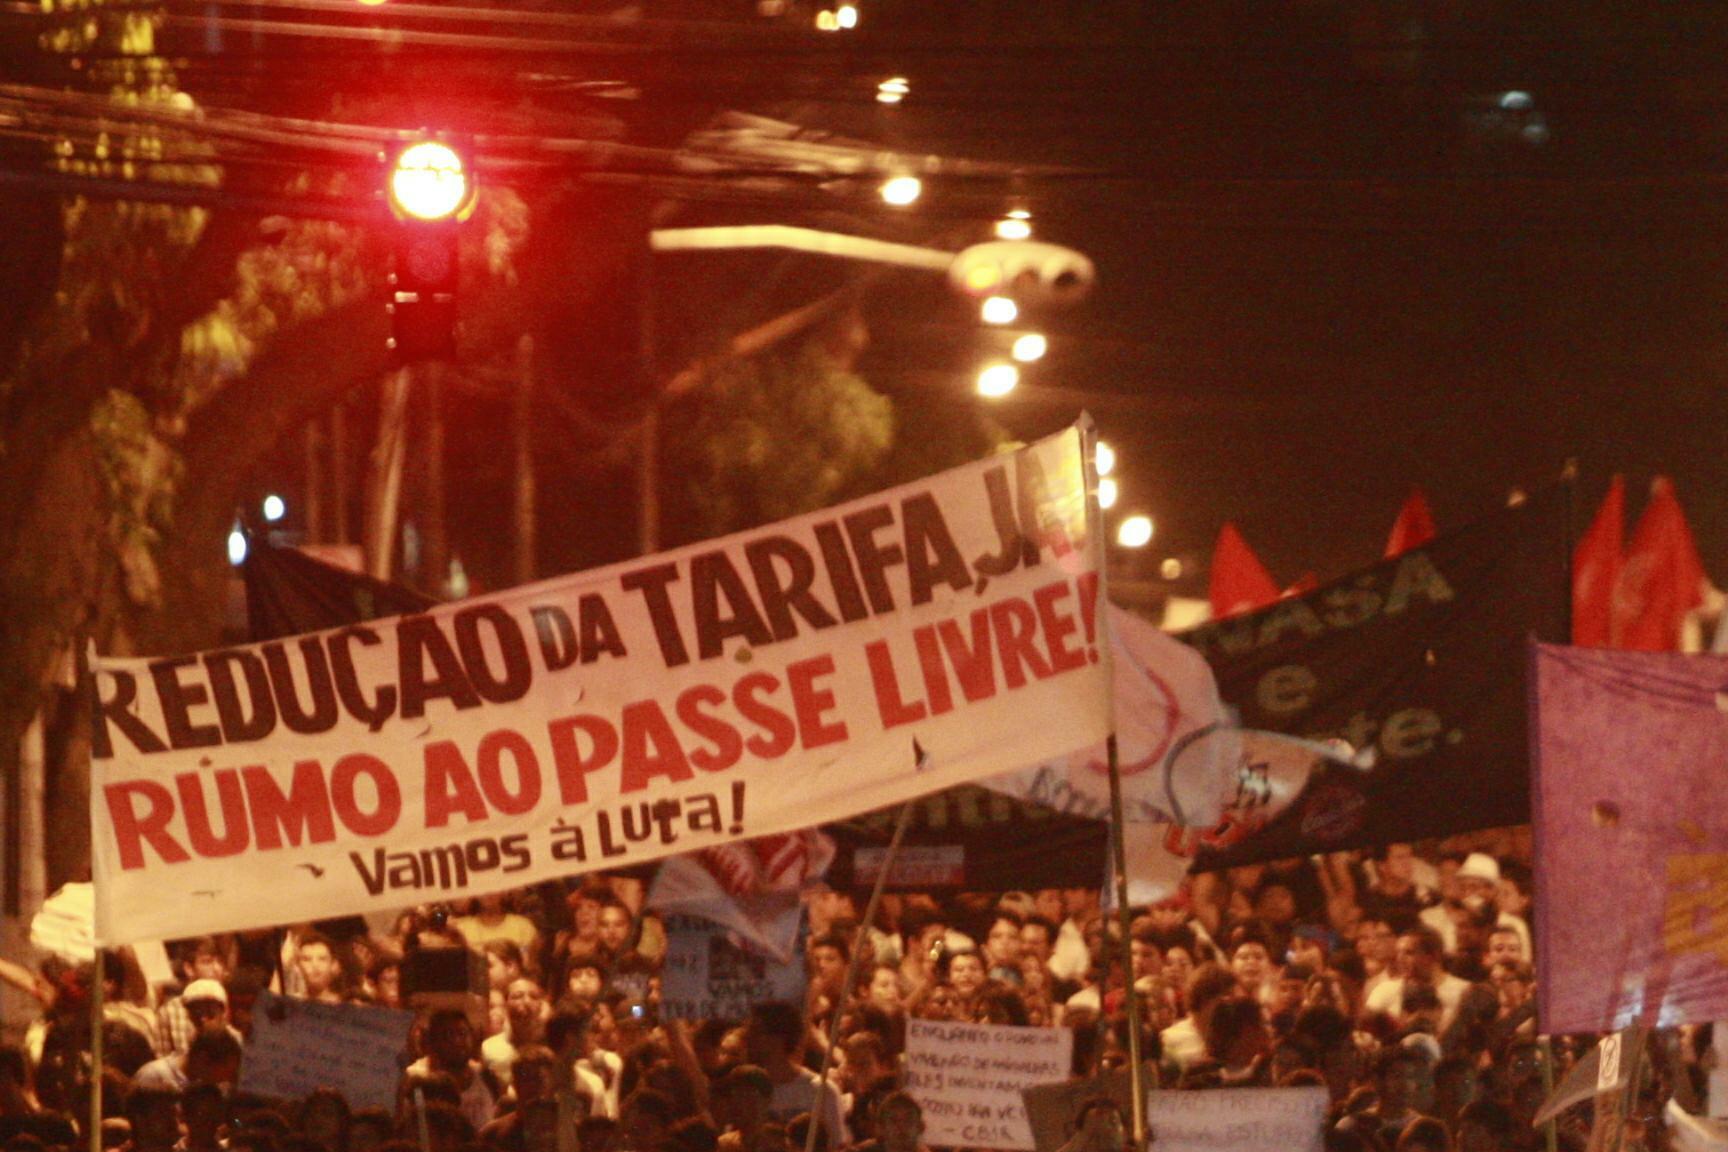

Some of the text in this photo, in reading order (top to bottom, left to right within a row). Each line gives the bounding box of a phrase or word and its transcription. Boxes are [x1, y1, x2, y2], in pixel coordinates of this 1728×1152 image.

[530, 592, 627, 672] DA
[621, 491, 988, 668] TARIFA,
[103, 571, 1099, 871] RUMO AO PASSE LIVRE!
[550, 817, 587, 863] à
